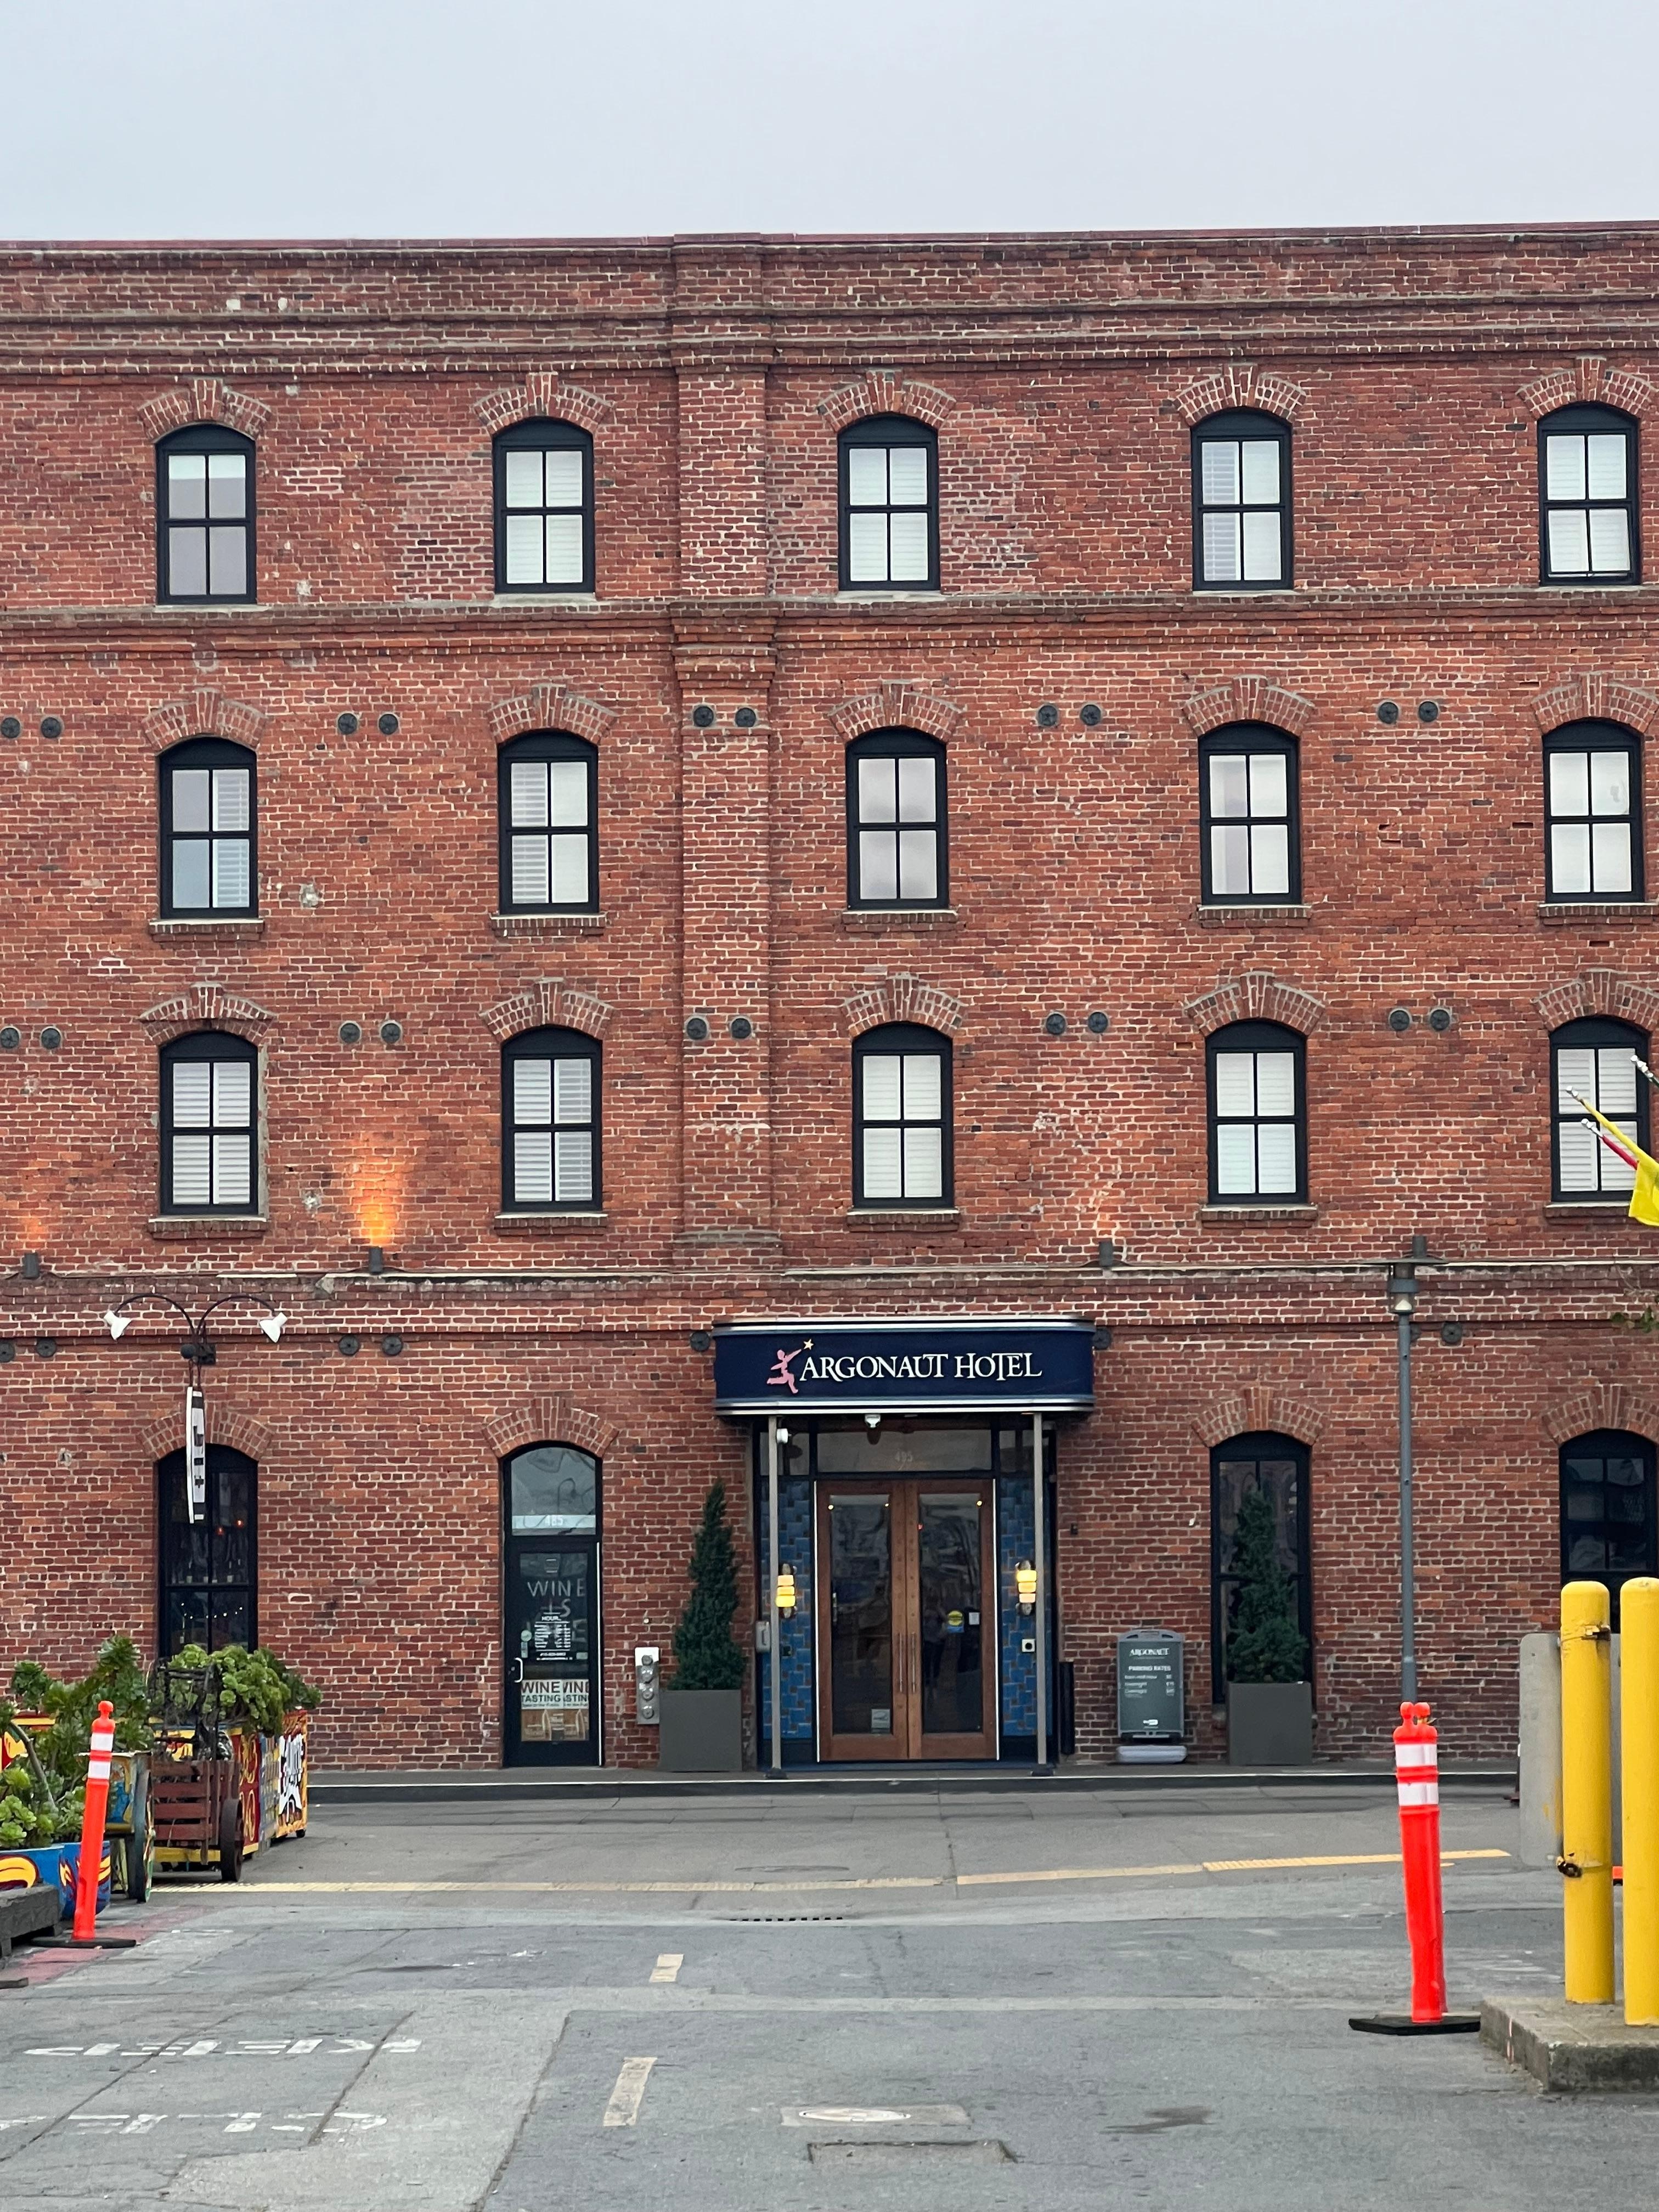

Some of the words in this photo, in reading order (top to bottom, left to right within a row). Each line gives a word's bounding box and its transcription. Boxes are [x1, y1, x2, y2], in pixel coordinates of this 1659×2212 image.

[799, 1353, 949, 1382] ARGONAUT
[954, 1352, 1042, 1381] HOTEL
[527, 1578, 586, 1598] WINE
[521, 1681, 561, 1694] WINE
[521, 1694, 561, 1702] TASTING
